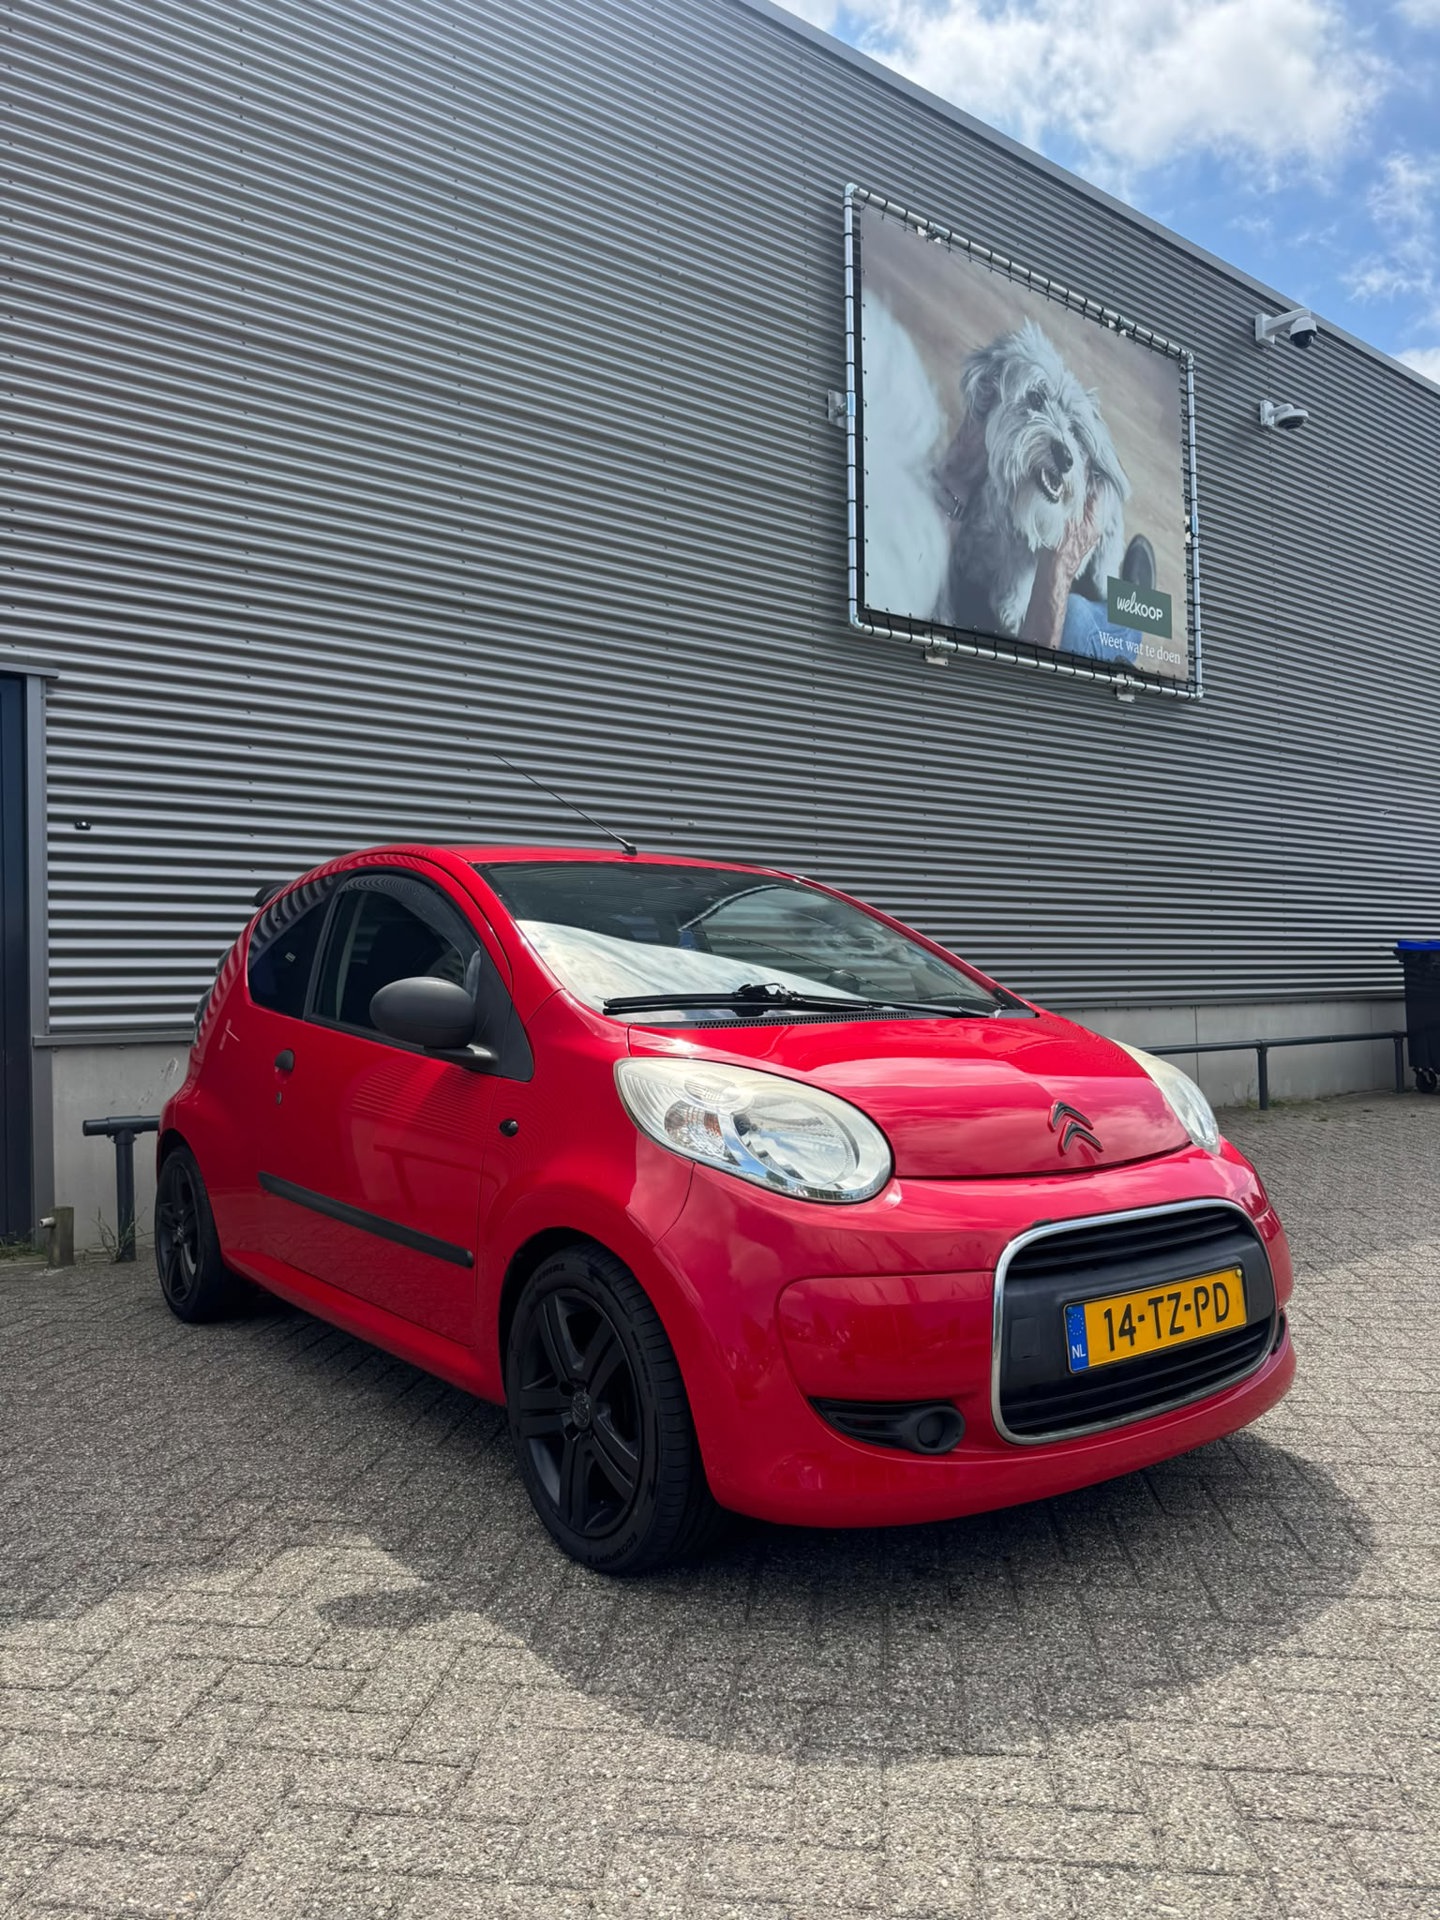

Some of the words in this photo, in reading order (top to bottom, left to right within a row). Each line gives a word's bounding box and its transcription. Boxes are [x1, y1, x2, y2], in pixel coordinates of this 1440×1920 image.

[1099, 631, 1123, 650] Weet
[1125, 640, 1143, 656] wat
[1146, 643, 1155, 658] te
[1156, 646, 1181, 665] doen
[1103, 1281, 1230, 1352] 14-TZ-PD
[1071, 1344, 1086, 1359] NL
